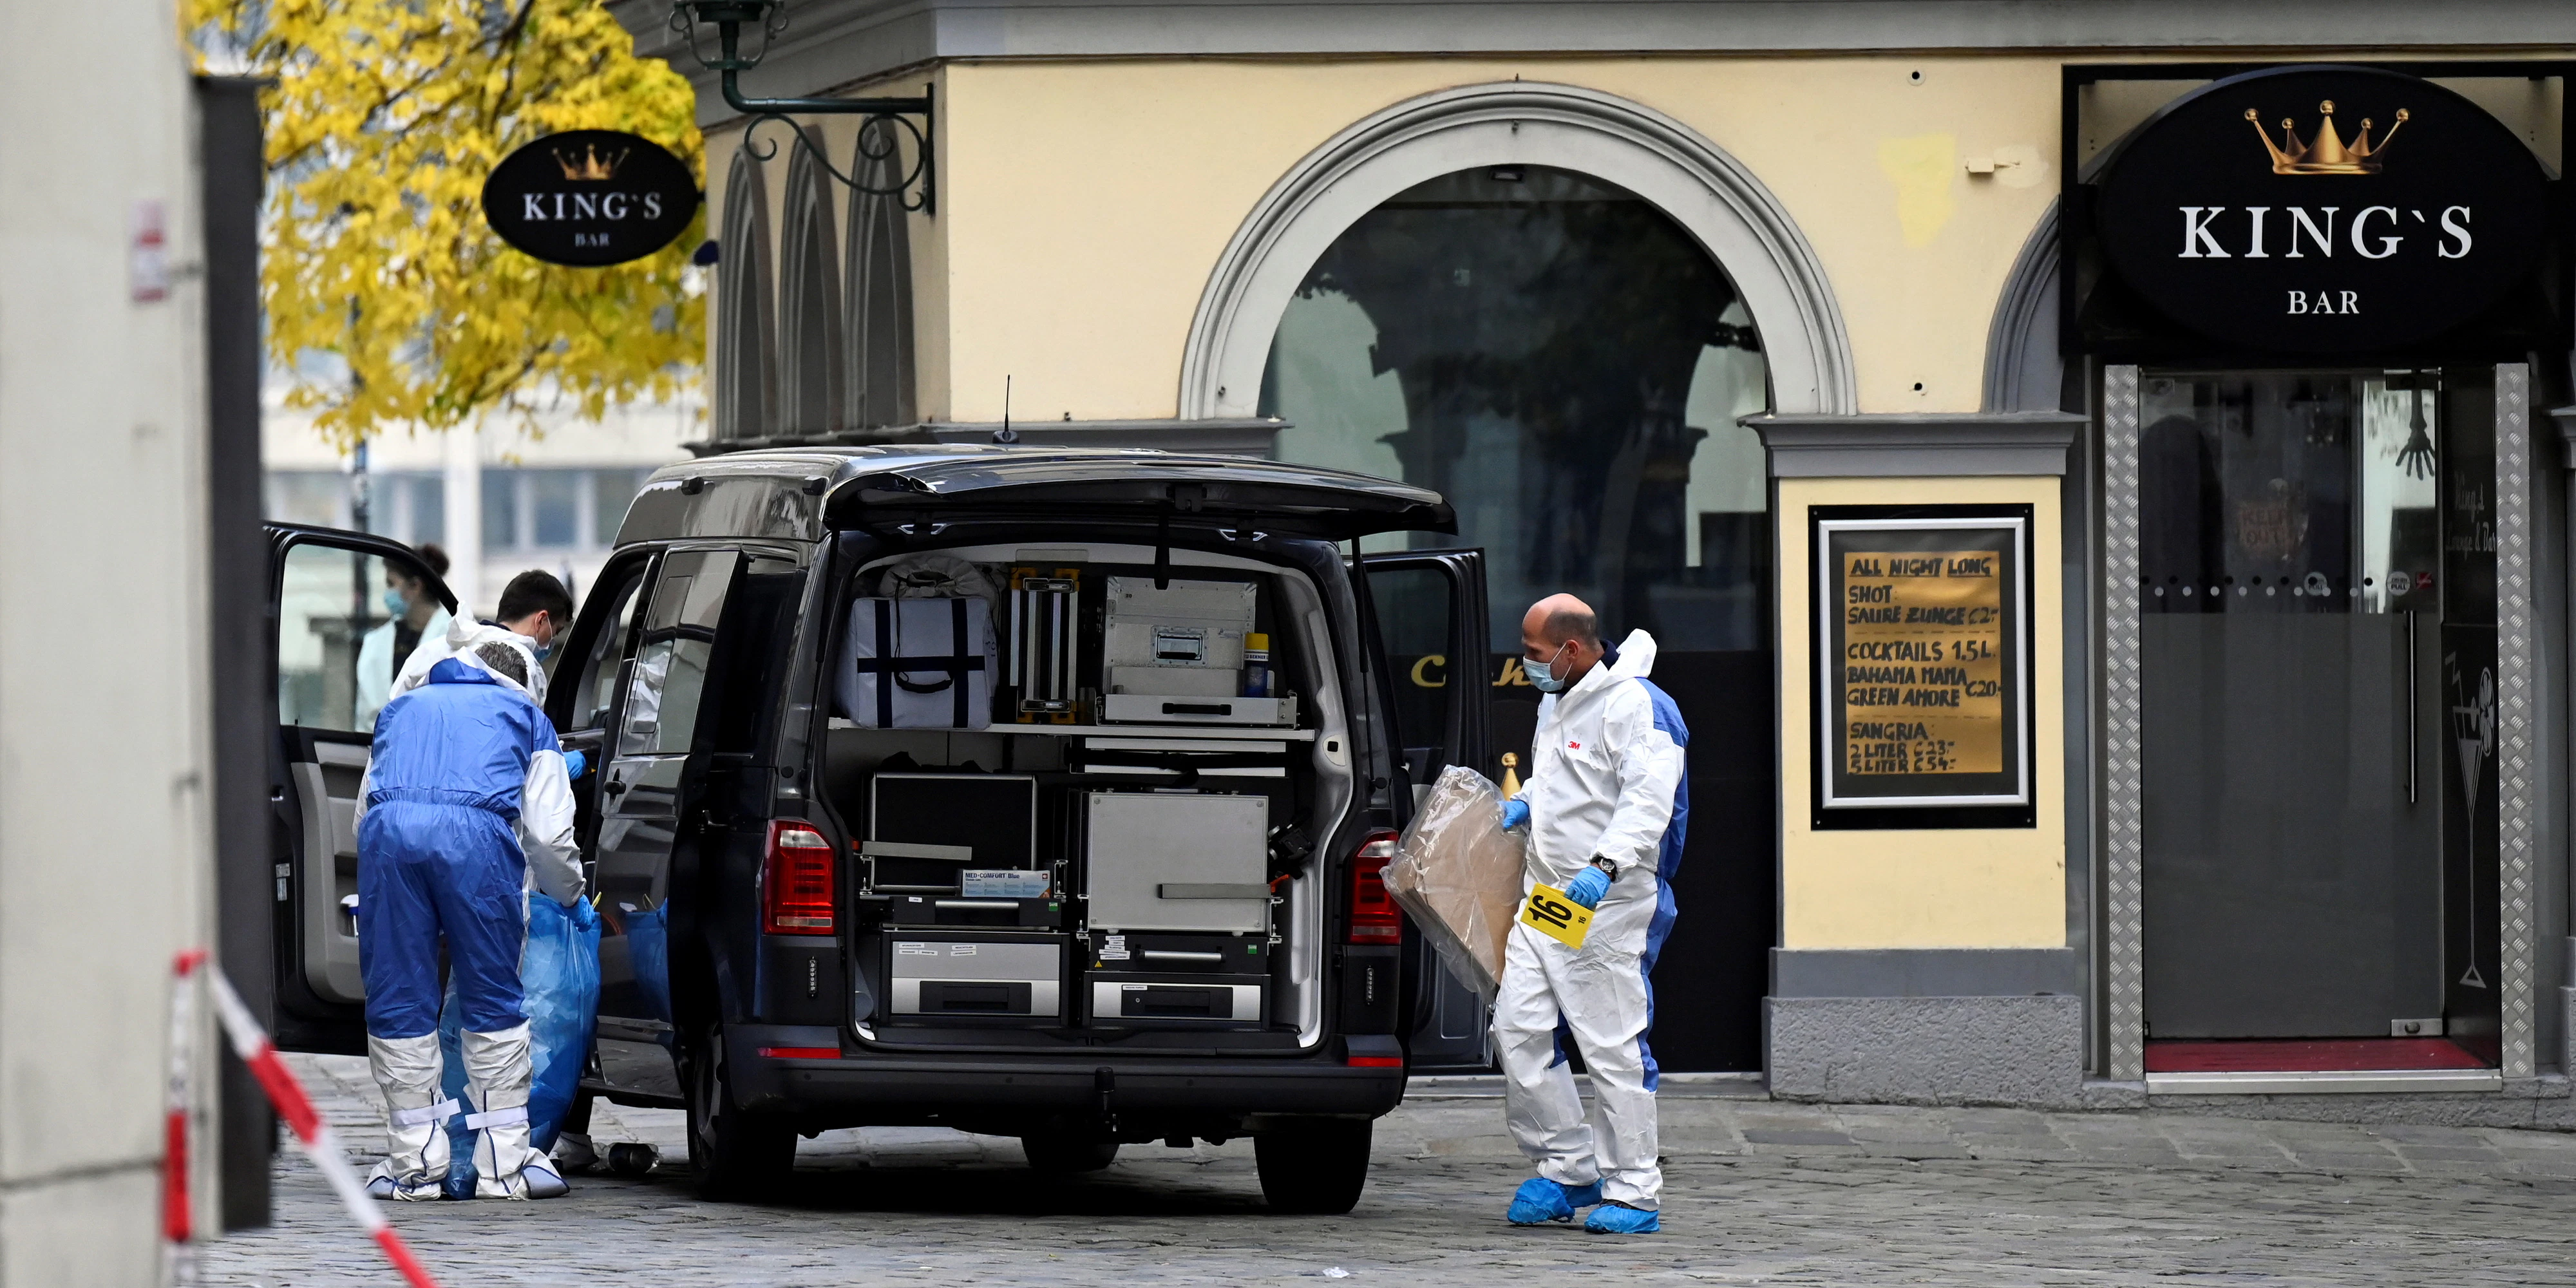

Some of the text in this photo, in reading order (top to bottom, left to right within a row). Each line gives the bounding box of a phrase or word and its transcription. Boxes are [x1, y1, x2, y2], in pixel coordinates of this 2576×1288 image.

[574, 232, 610, 247] BAR
[2287, 290, 2360, 314] BAR
[1851, 557, 1992, 576] ALL NIGHT LONG
[1847, 641, 1944, 661] COCKTAILS
[1847, 666, 1967, 685] BAHAMA MAMA
[1847, 687, 1960, 706] GREEN AMORE
[1568, 741, 1580, 750] 3M
[1850, 743, 1862, 759] 2
[1864, 743, 1908, 759] LITER
[1851, 759, 1862, 773] 5
[1864, 759, 1909, 773] LITER
[1528, 895, 1573, 929] 16
[1578, 916, 1586, 924] 16
